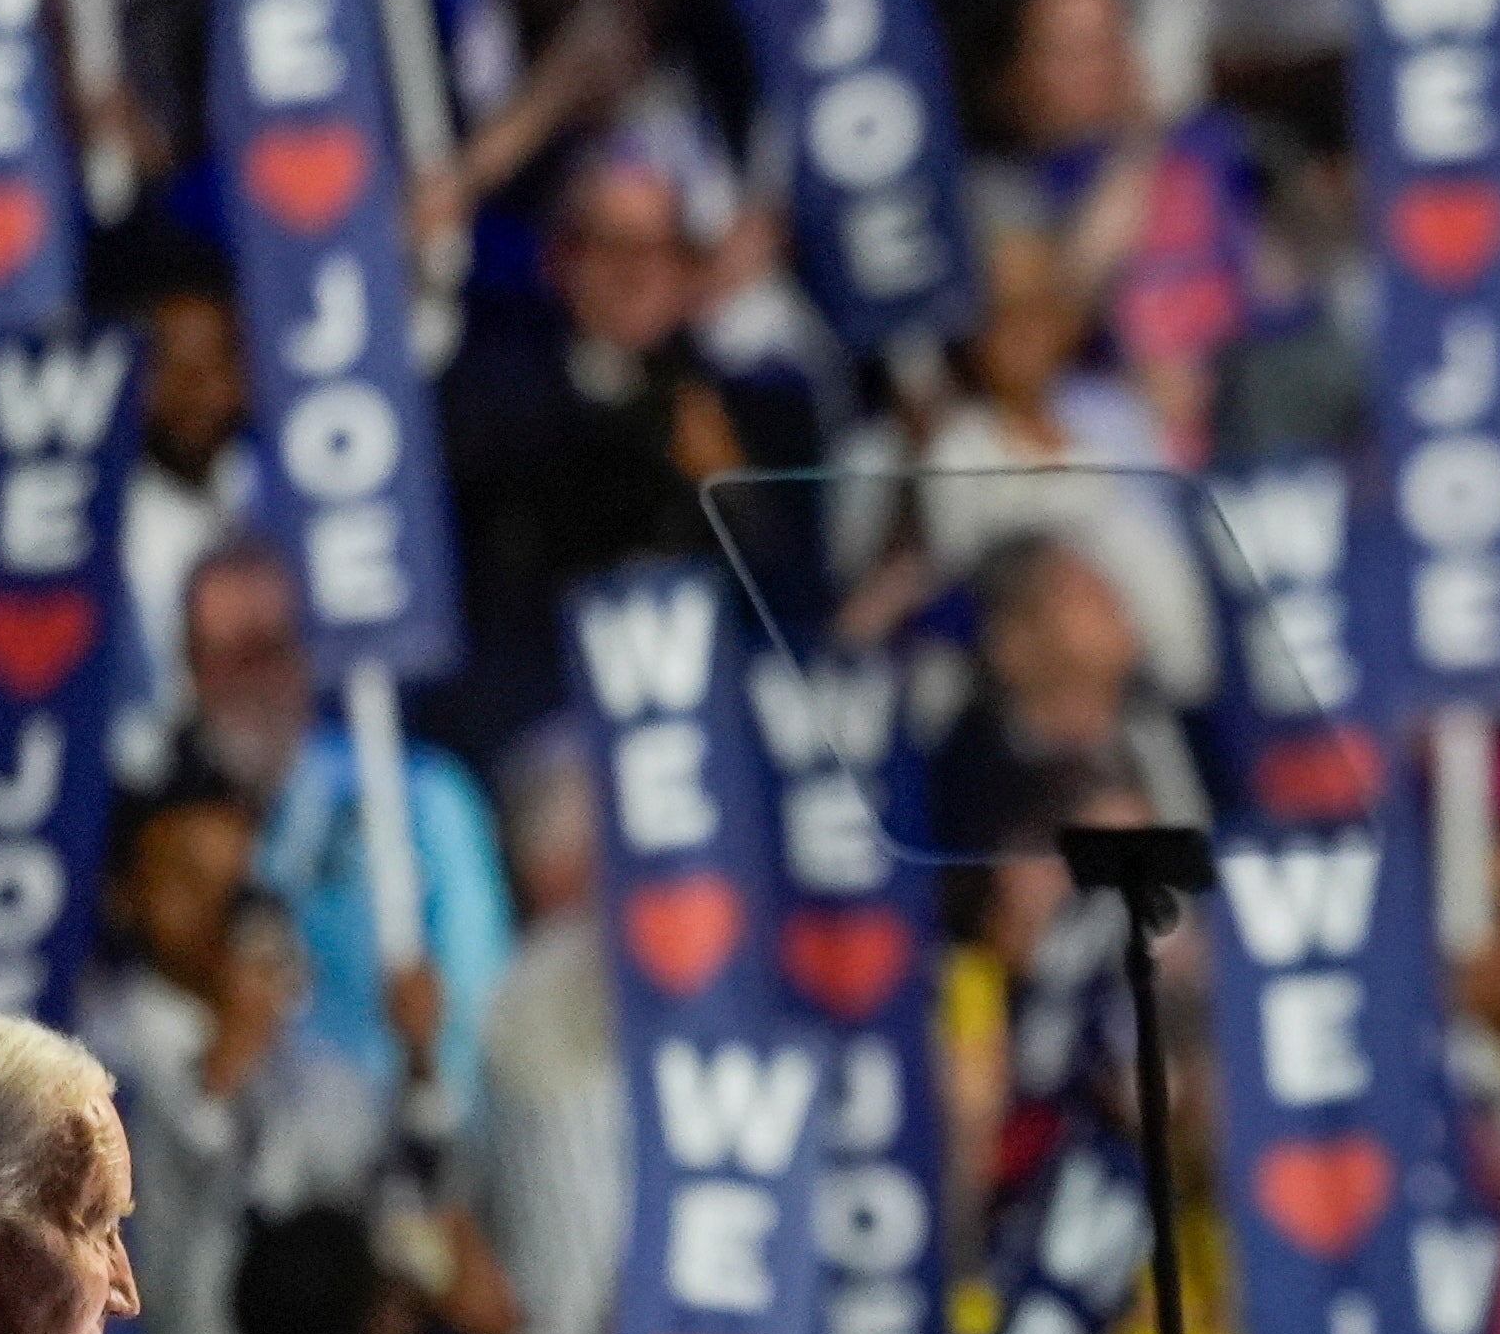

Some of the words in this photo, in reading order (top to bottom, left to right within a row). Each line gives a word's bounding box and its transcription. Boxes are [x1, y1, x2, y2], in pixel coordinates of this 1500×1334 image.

[275, 267, 422, 629] JOE
[578, 587, 717, 874] WE
[750, 679, 900, 899] WE
[1215, 855, 1382, 1109] WE
[655, 1055, 820, 1319] WE
